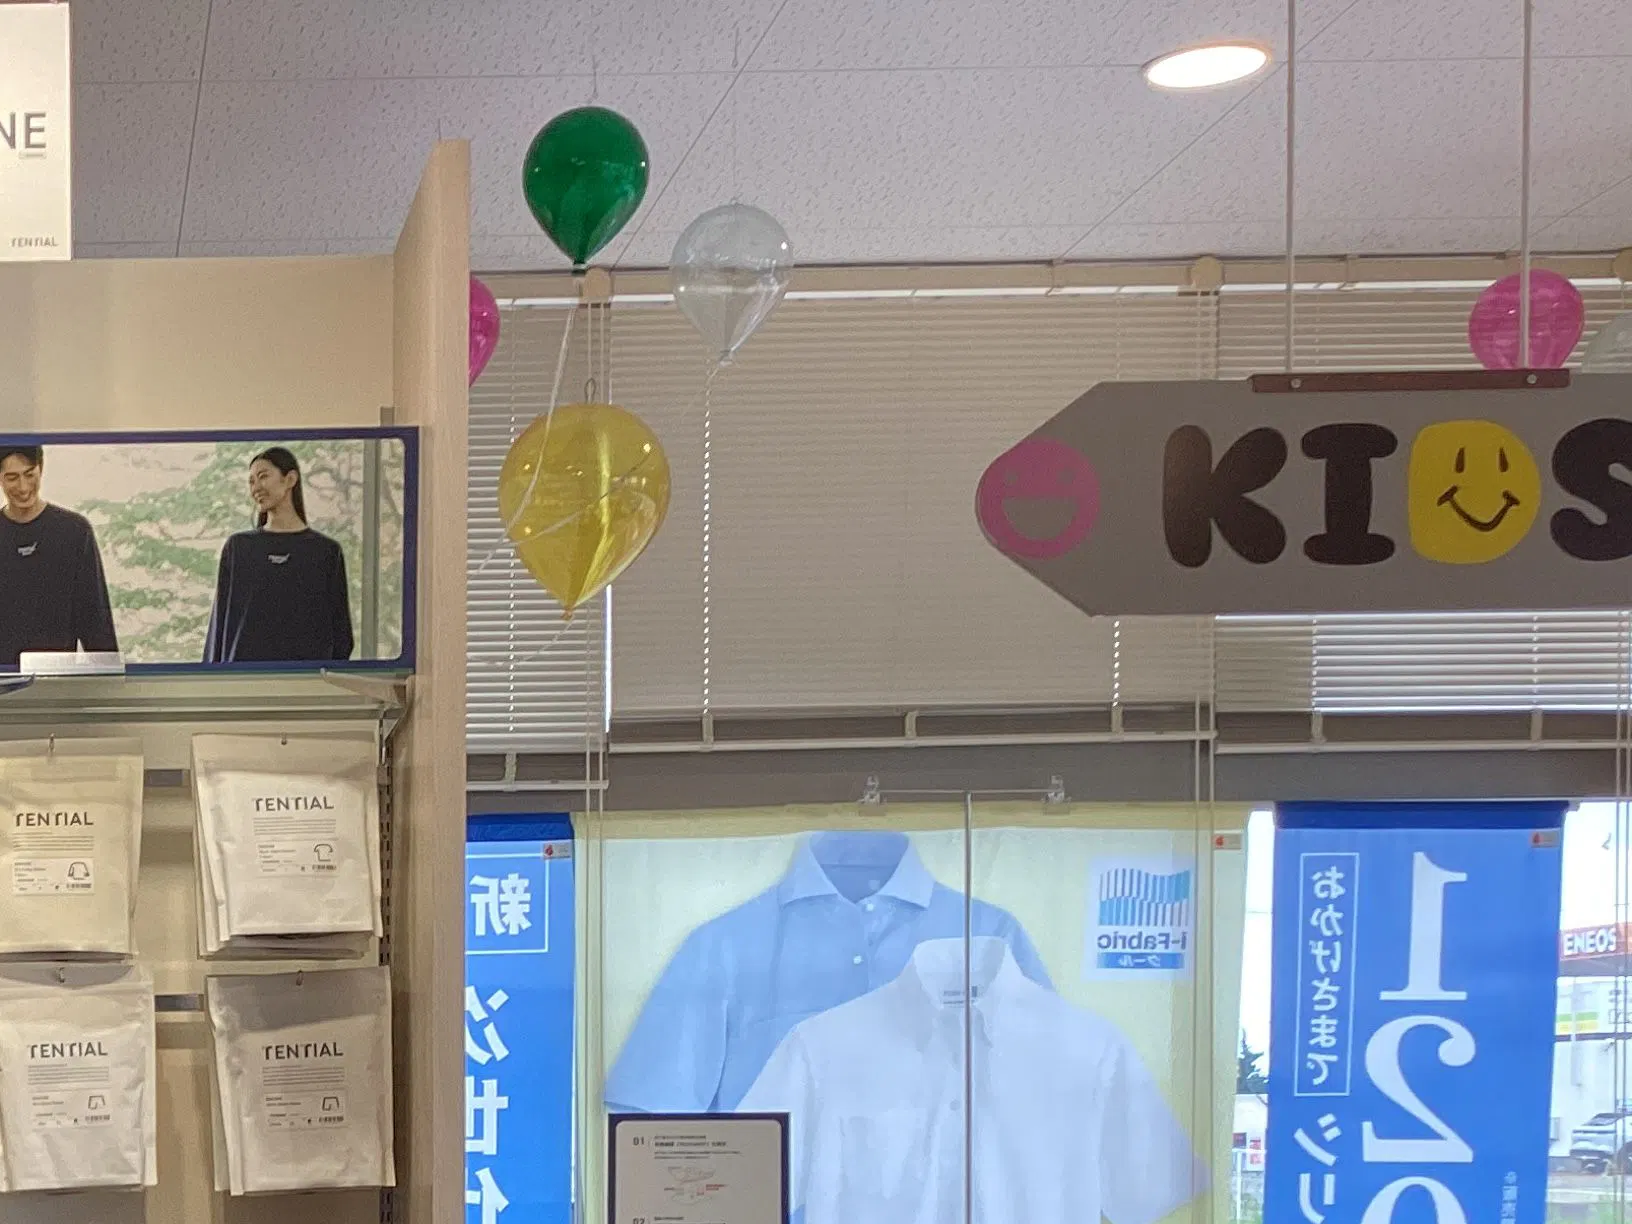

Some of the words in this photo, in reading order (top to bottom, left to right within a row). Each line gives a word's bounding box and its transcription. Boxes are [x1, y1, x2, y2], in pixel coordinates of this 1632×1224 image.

[10, 235, 59, 249] TENTIAL
[253, 796, 335, 812] TENTIAL
[14, 812, 94, 827] TENTIAL
[1564, 927, 1617, 956] ENEOS
[27, 1041, 109, 1059] TENTIAL
[263, 1041, 344, 1058] TENTIAL
